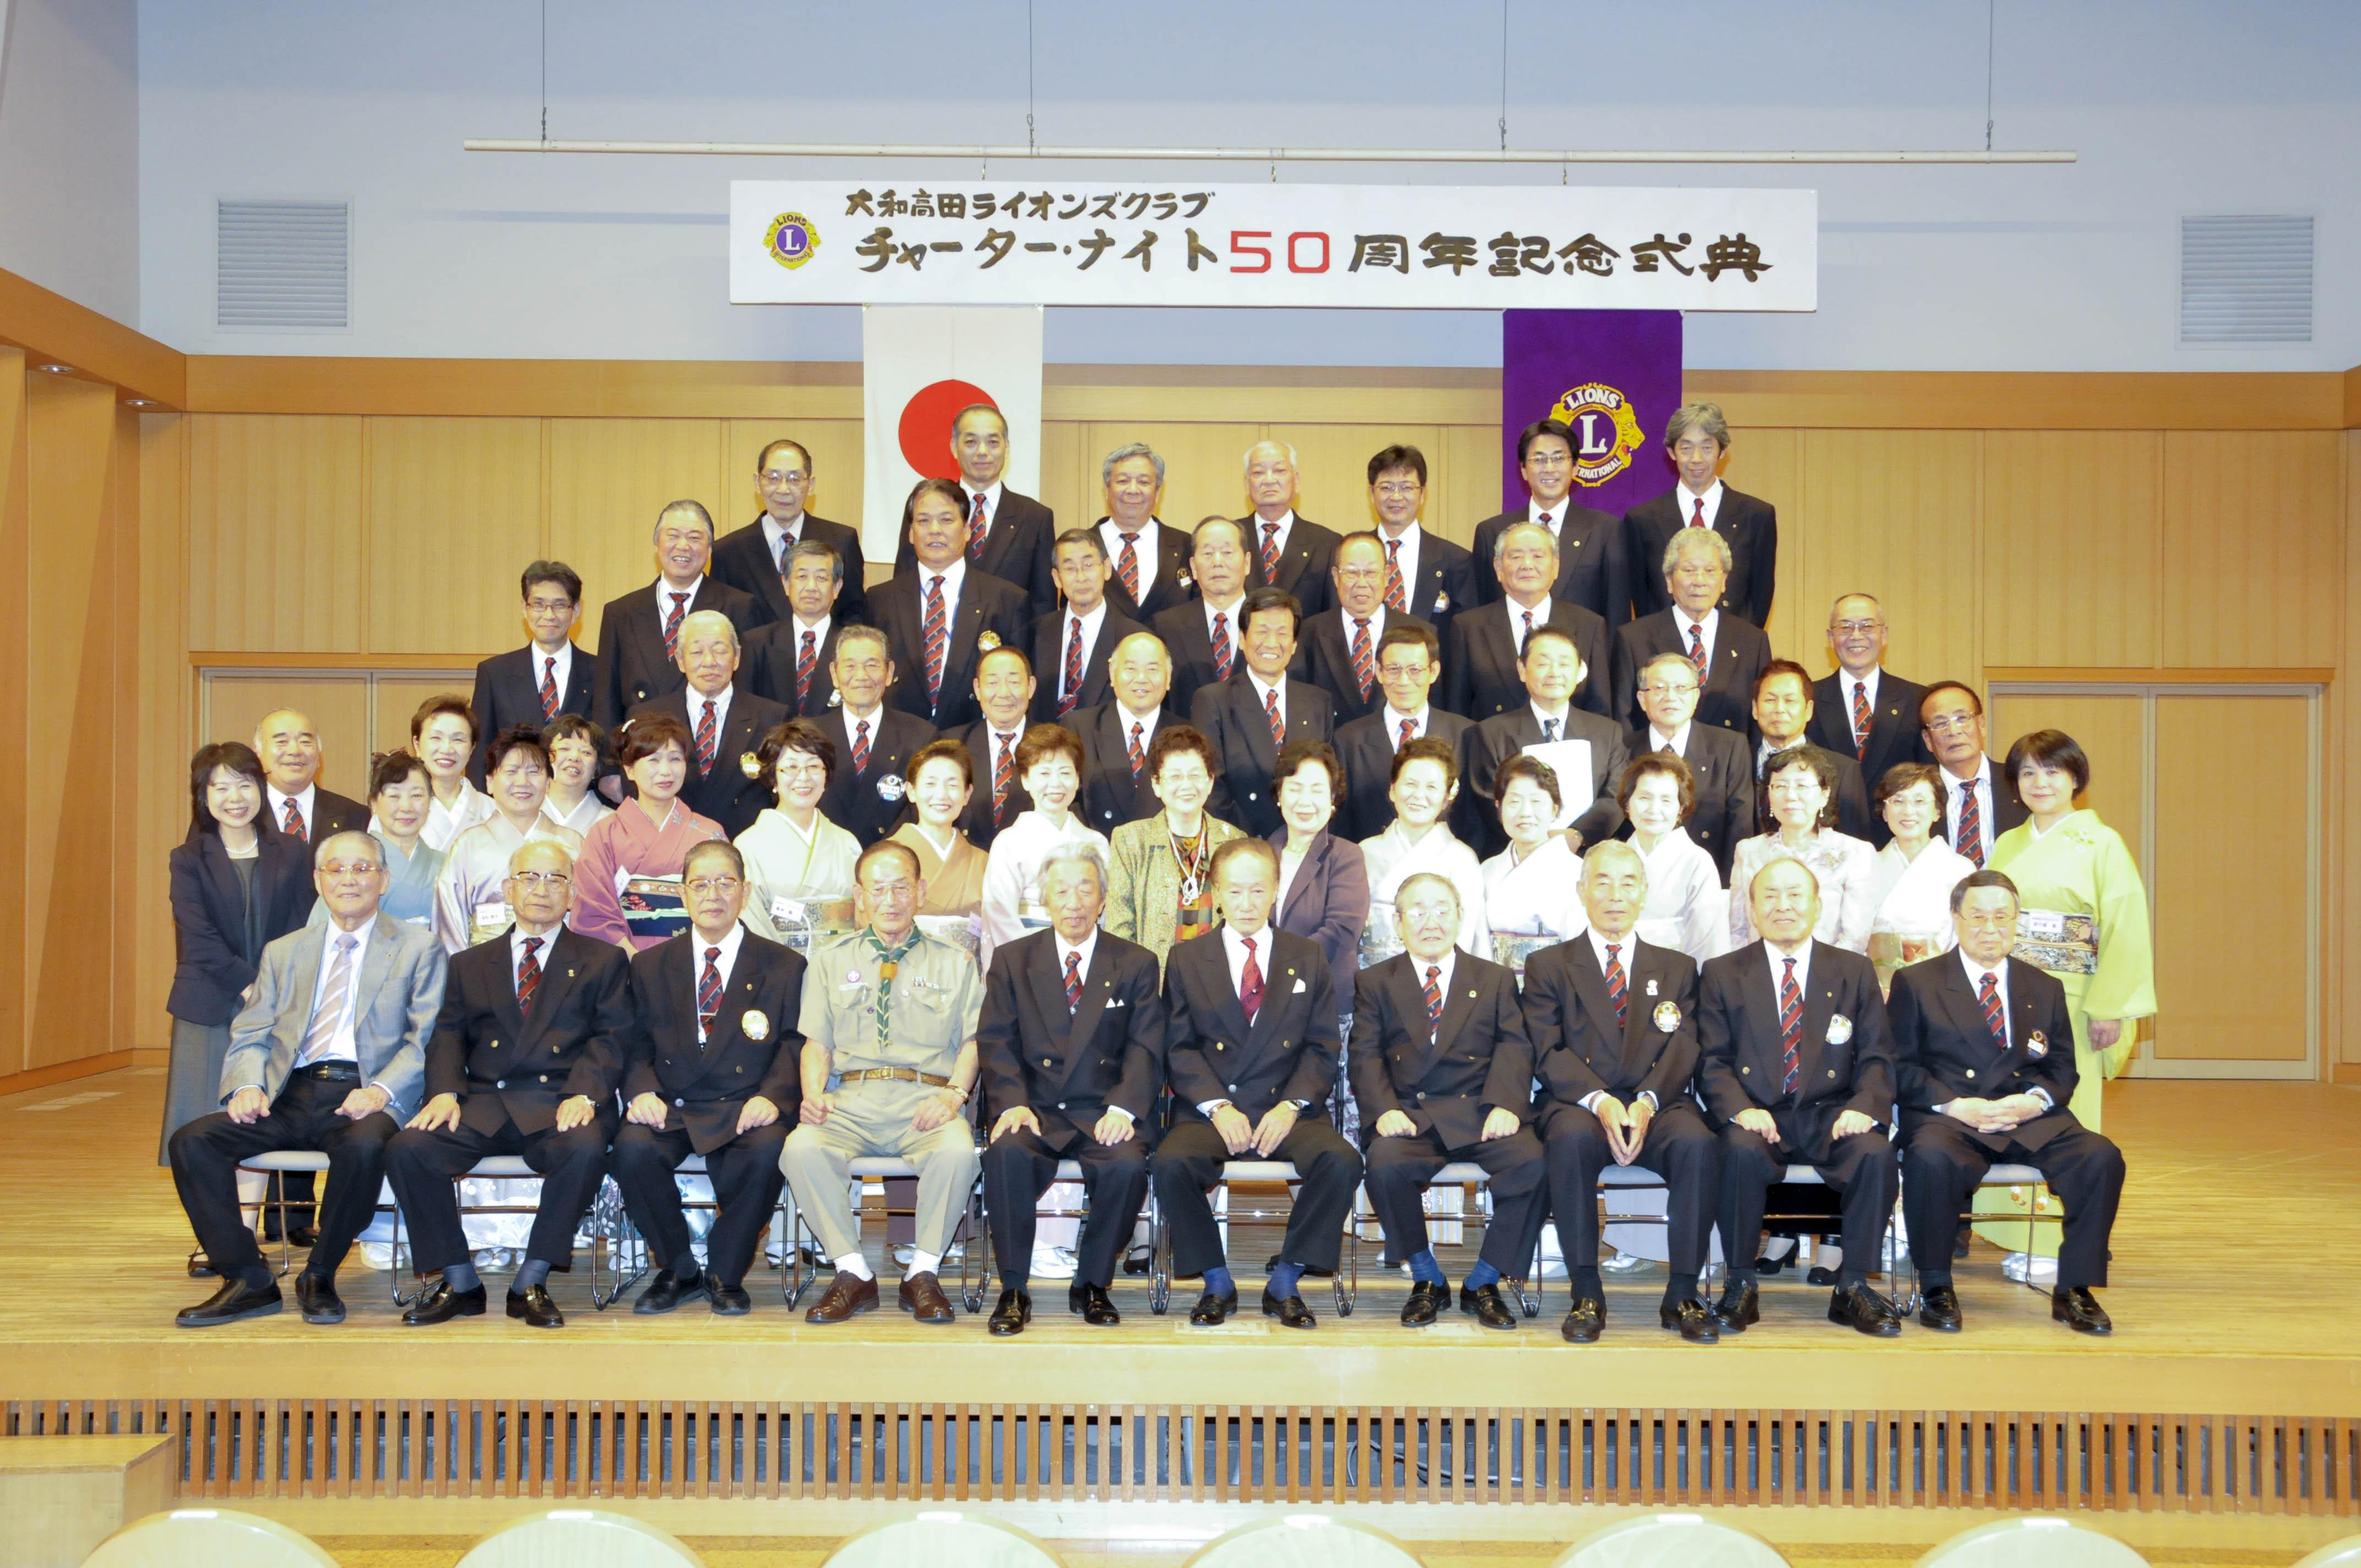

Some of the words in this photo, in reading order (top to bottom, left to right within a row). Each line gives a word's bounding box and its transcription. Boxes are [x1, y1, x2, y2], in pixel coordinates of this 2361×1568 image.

[845, 188, 1216, 221] 大和高田ライオンズクラブ
[776, 214, 807, 226] LIONS
[784, 228, 801, 251] L
[1565, 388, 1620, 410] LIONS
[1579, 415, 1608, 454] L
[1576, 458, 1623, 478] RNATIONAL
